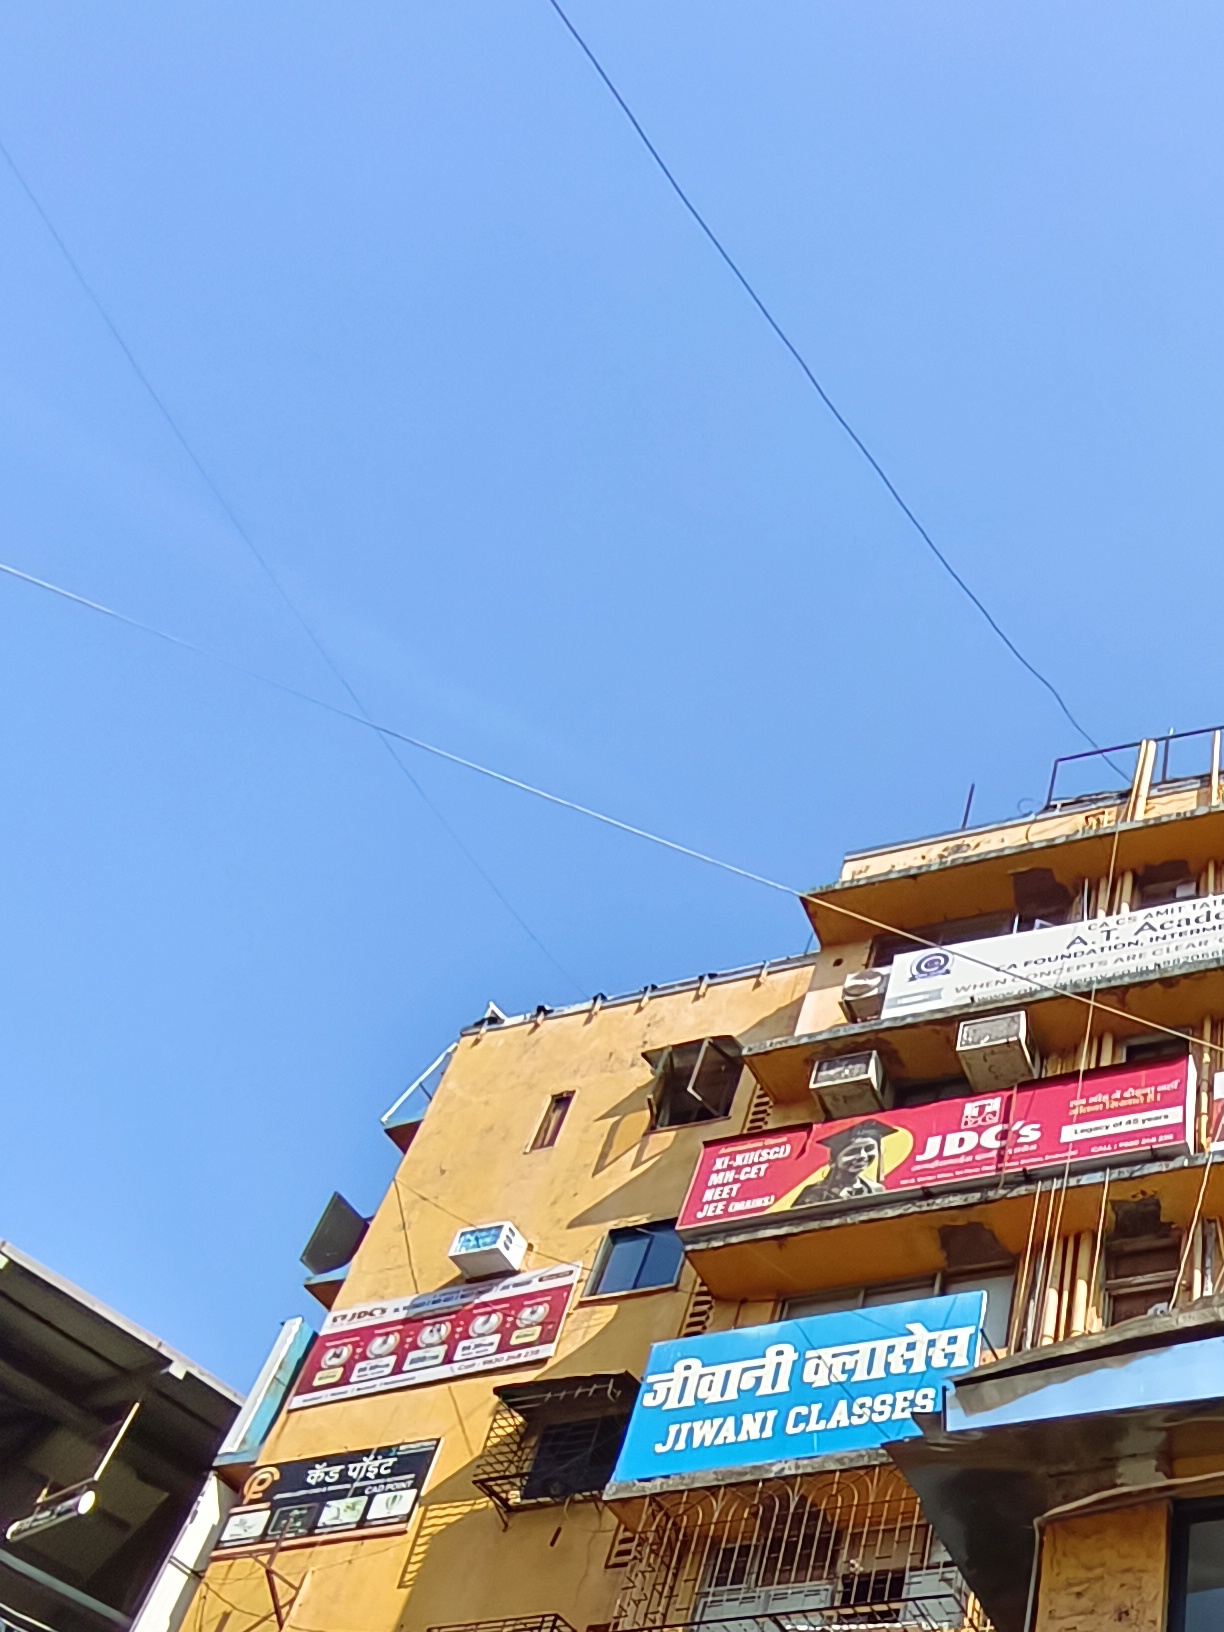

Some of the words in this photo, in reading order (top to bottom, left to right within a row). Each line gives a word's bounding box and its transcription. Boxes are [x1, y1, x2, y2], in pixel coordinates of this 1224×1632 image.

[915, 1119, 1041, 1163] JDC's
[708, 1164, 769, 1187] MH-CET
[702, 1183, 741, 1203] NEET
[696, 1201, 726, 1219] JEE
[642, 1342, 799, 1411] जीवानी
[803, 1322, 977, 1389] क्लासेस
[654, 1410, 778, 1455] JIWANI
[785, 1386, 937, 1436] CLASSES
